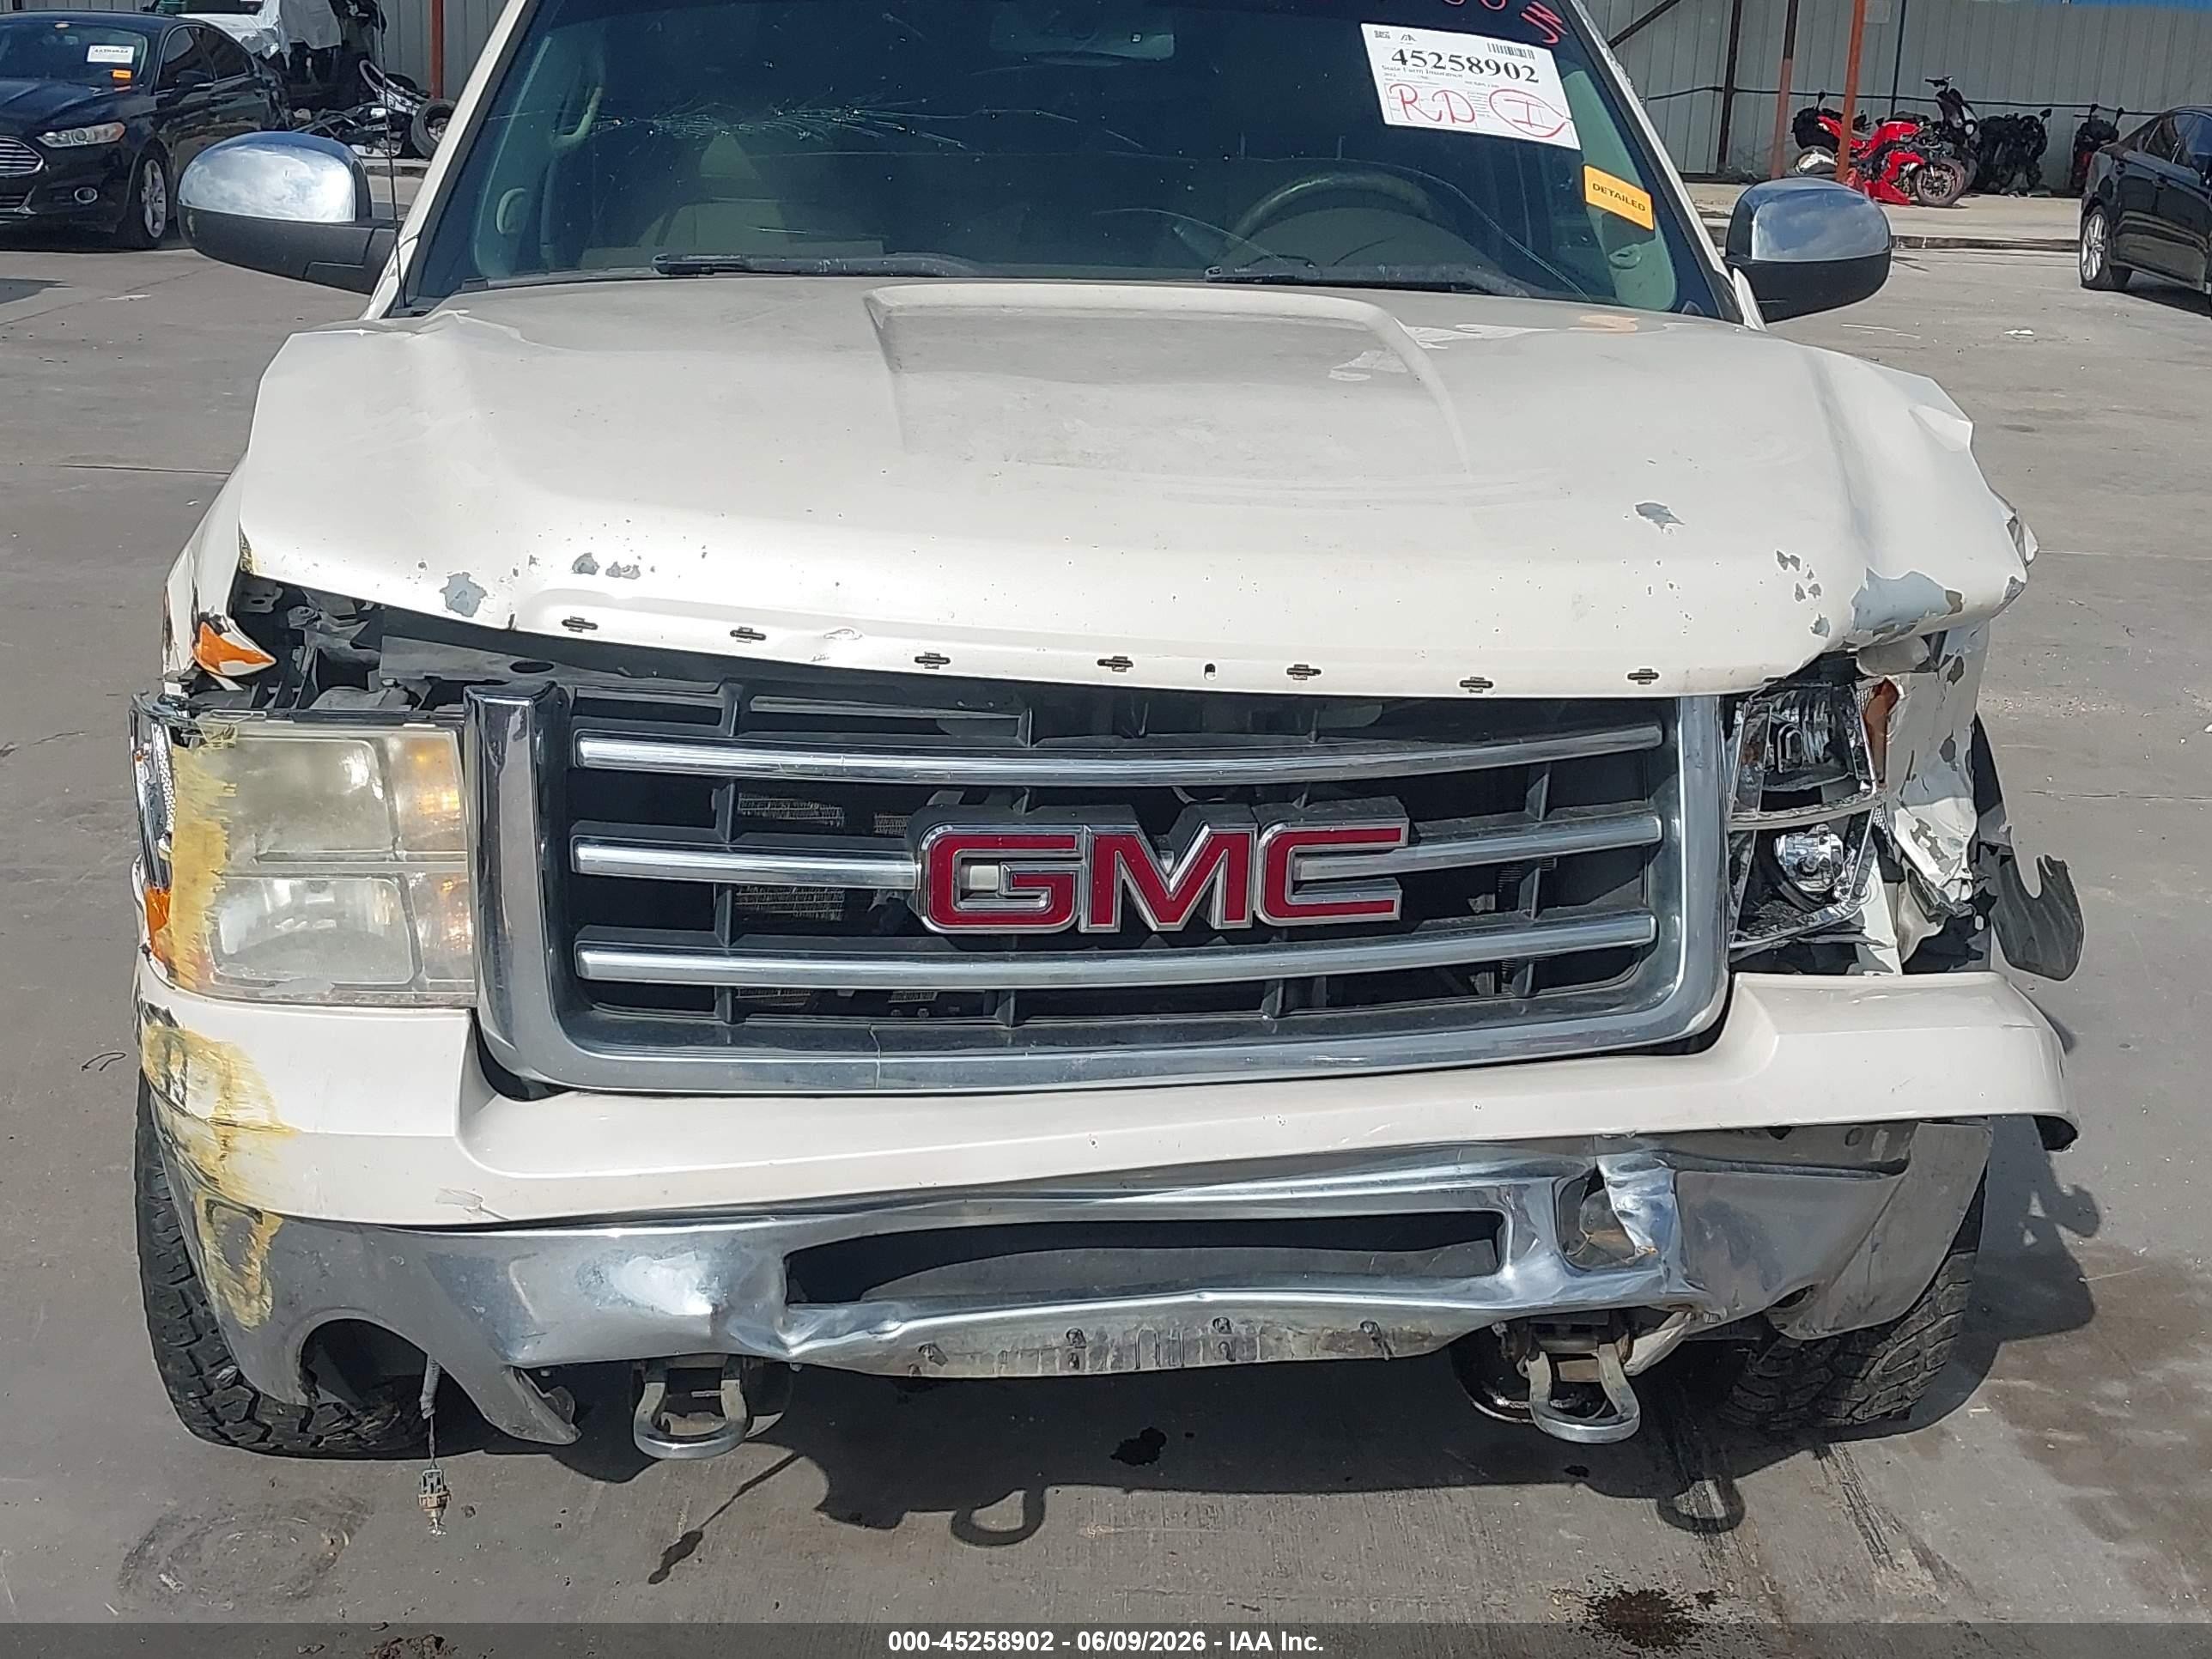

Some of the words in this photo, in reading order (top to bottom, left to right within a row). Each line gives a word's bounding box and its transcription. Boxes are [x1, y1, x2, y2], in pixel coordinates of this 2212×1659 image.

[1391, 48, 1539, 83] 45258902
[1592, 182, 1647, 212] DETAILED
[919, 817, 1411, 936] GMC
